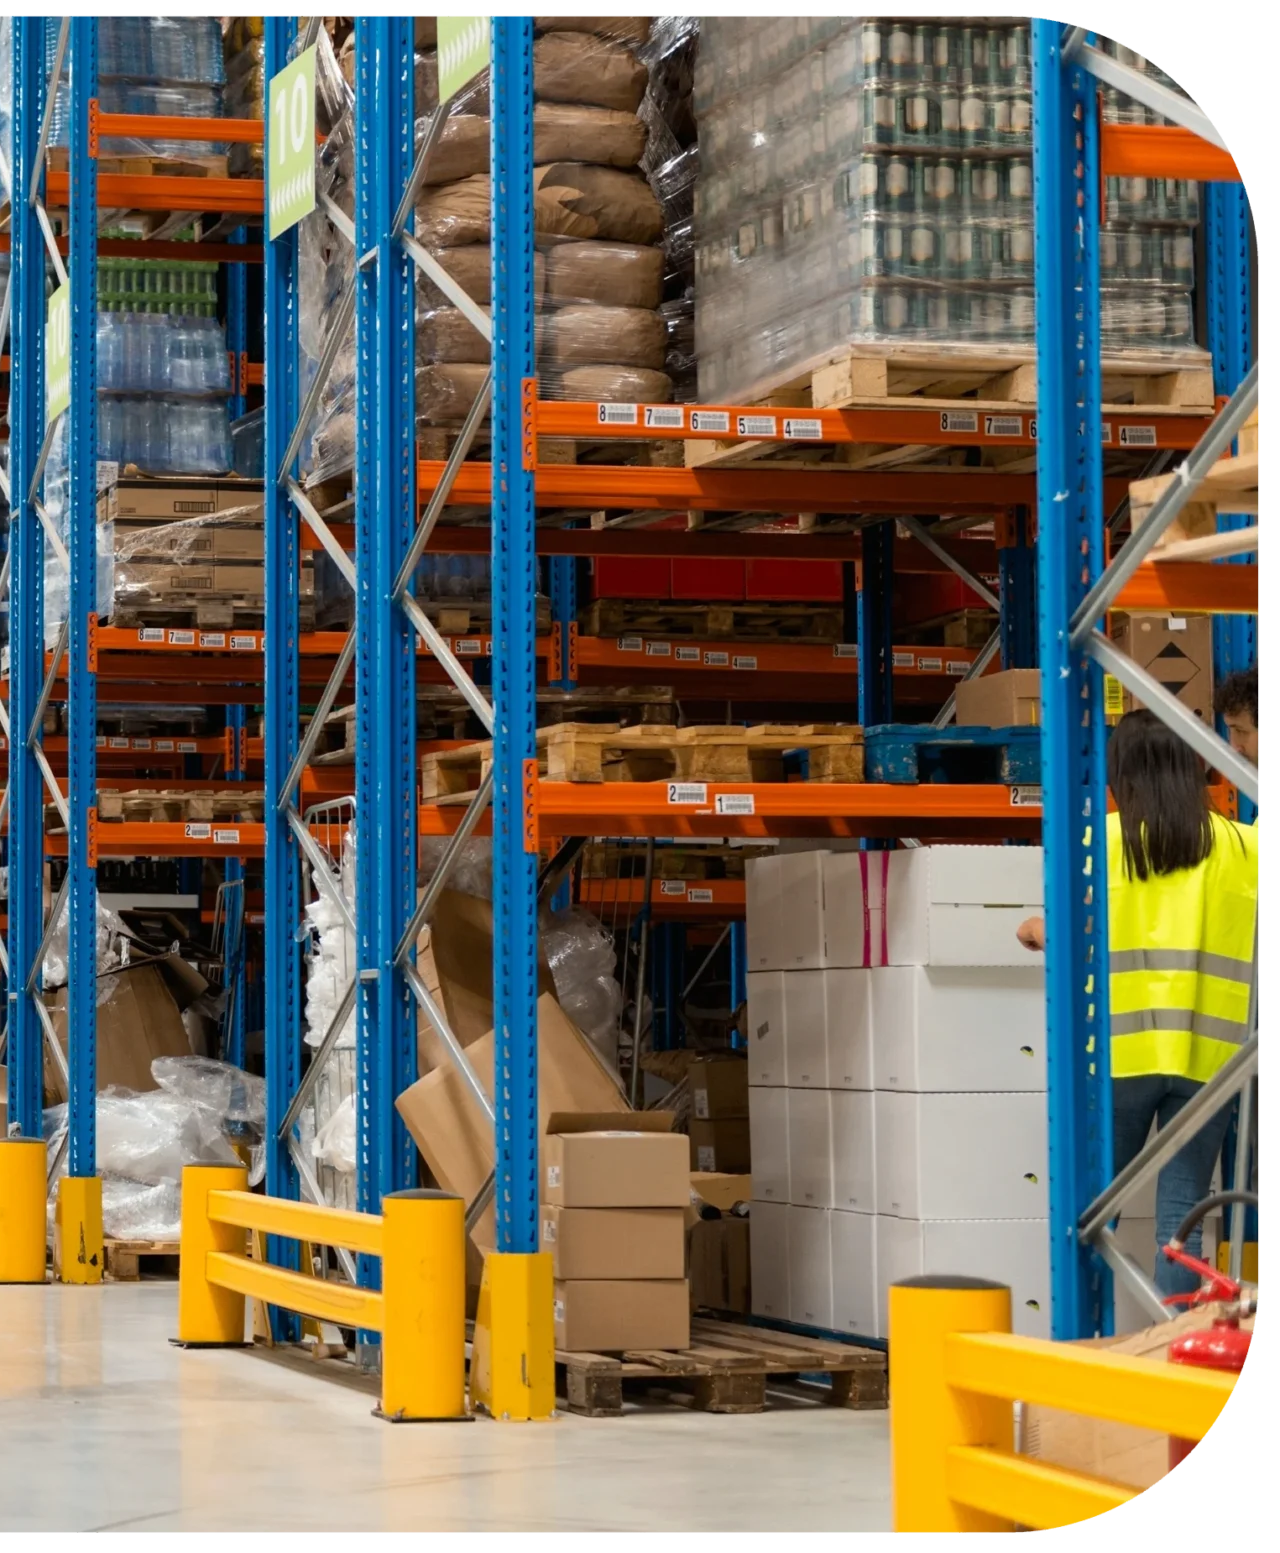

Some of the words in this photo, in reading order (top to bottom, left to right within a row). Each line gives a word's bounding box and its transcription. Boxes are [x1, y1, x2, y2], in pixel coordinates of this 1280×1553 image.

[275, 72, 308, 165] 10
[51, 298, 68, 366] 10
[599, 405, 606, 421] 8
[646, 408, 653, 425] 7
[692, 413, 699, 430] 6
[739, 417, 746, 434] 5
[784, 420, 792, 437] 4
[941, 413, 948, 430] 8
[986, 417, 993, 434] 7
[1030, 421, 1037, 437] 6
[1120, 427, 1128, 444] 4
[139, 628, 144, 641] 8
[170, 631, 175, 643] 7
[200, 635, 205, 646] 6
[230, 637, 236, 648] 5
[456, 641, 461, 652] 5
[647, 642, 652, 655] 7
[676, 648, 681, 660] 6
[705, 652, 710, 664] 5
[733, 656, 738, 669] 4
[946, 662, 952, 674] 4
[669, 785, 676, 802] 2
[1012, 787, 1019, 804] 2
[717, 796, 723, 812] 1
[186, 824, 191, 836] 2
[215, 831, 219, 842] 1
[661, 881, 666, 893] 2
